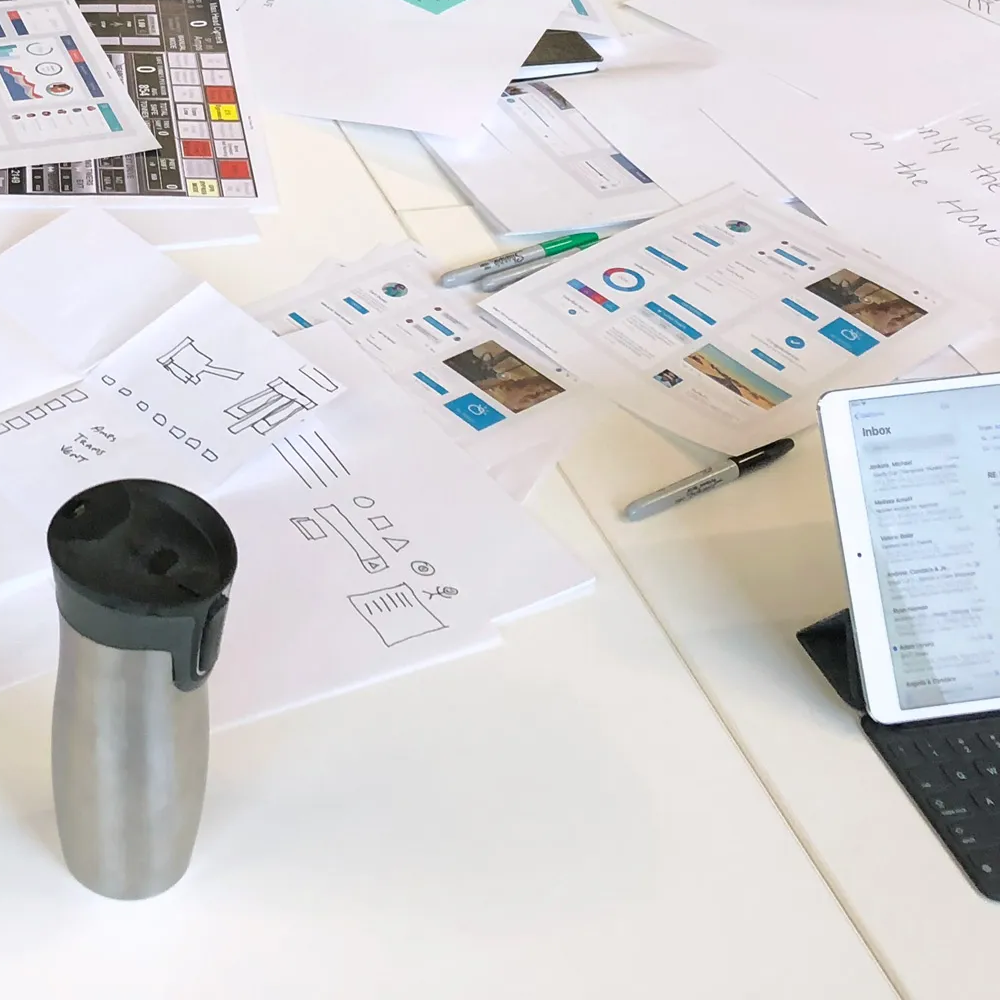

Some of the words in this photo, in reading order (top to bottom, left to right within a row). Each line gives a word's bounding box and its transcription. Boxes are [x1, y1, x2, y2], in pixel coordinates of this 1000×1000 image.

[138, 84, 150, 95] 854
[150, 104, 158, 115] SAFE
[158, 102, 168, 116] TOTAL
[850, 131, 885, 150] on
[894, 161, 928, 187] the
[862, 426, 892, 437] Inbox
[956, 771, 968, 780] Q
[986, 766, 998, 776] W
[986, 798, 996, 807] A
